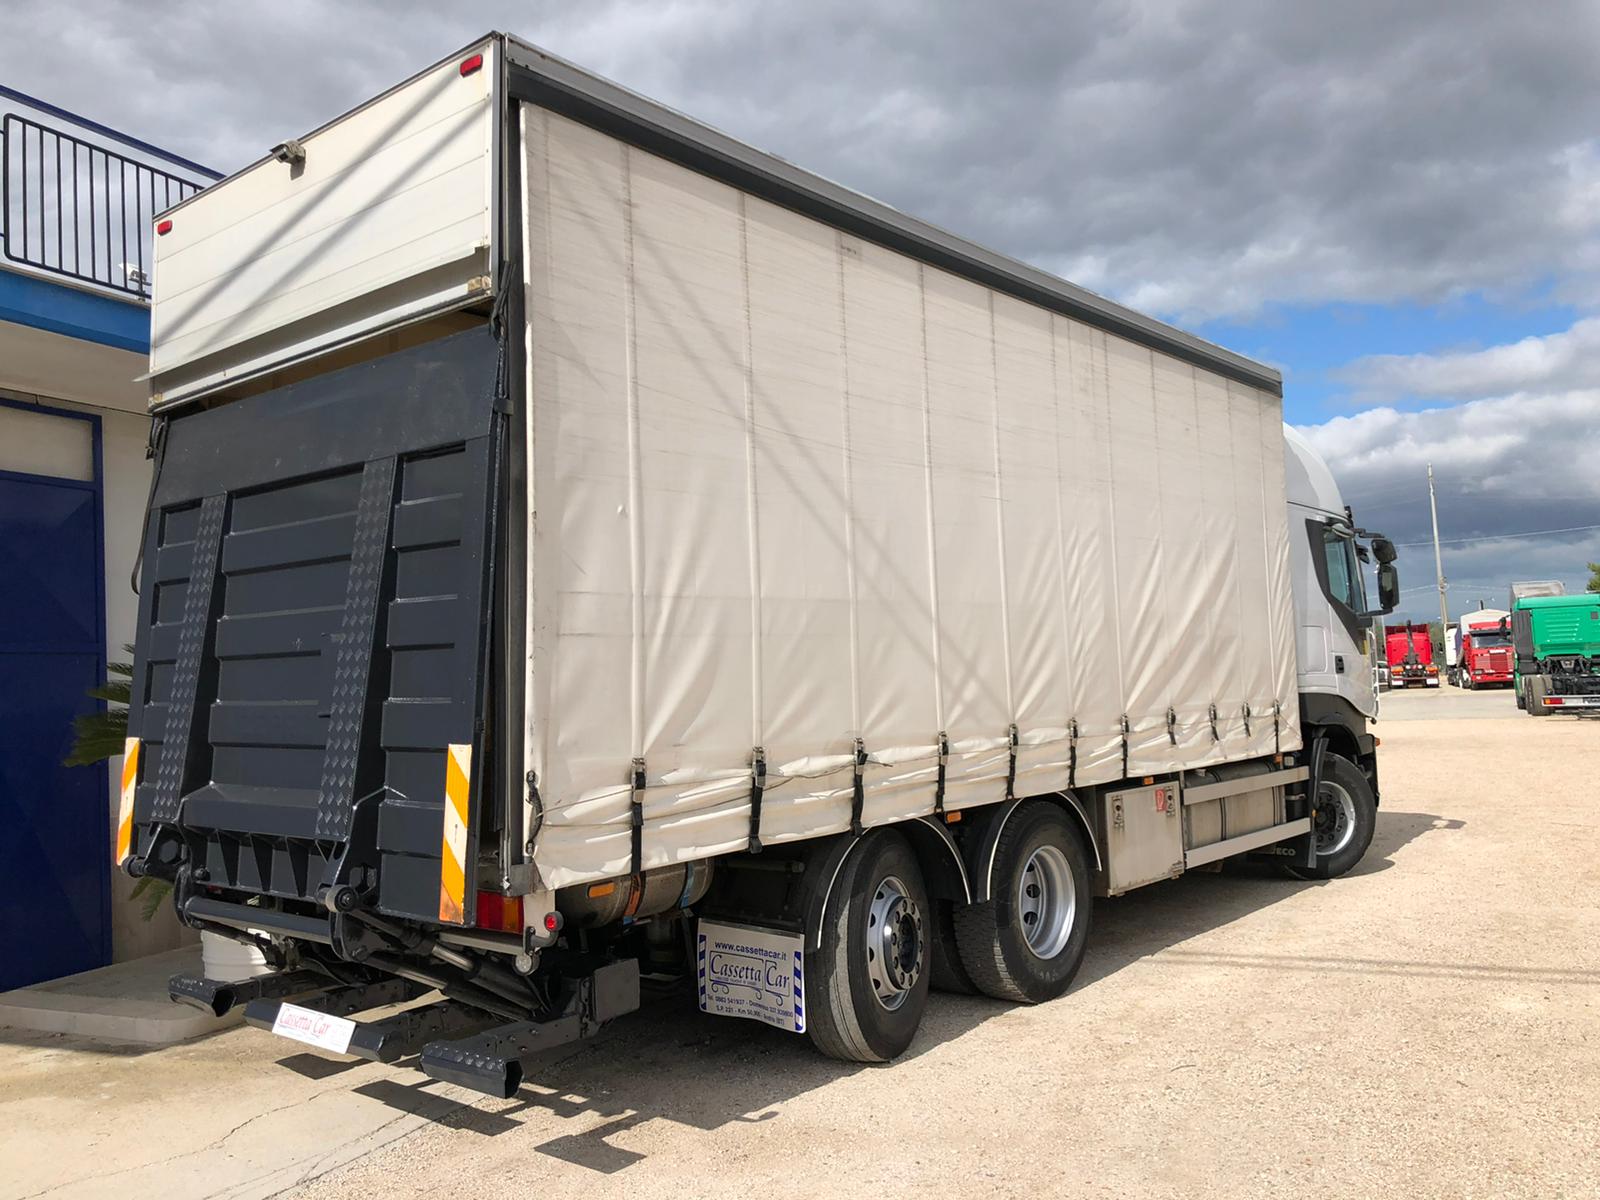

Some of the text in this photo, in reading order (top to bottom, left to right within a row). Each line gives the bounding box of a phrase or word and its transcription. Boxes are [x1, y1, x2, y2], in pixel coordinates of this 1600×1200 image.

[714, 941, 787, 961] www.cassettacar.it
[710, 954, 790, 989] Cassetta Car
